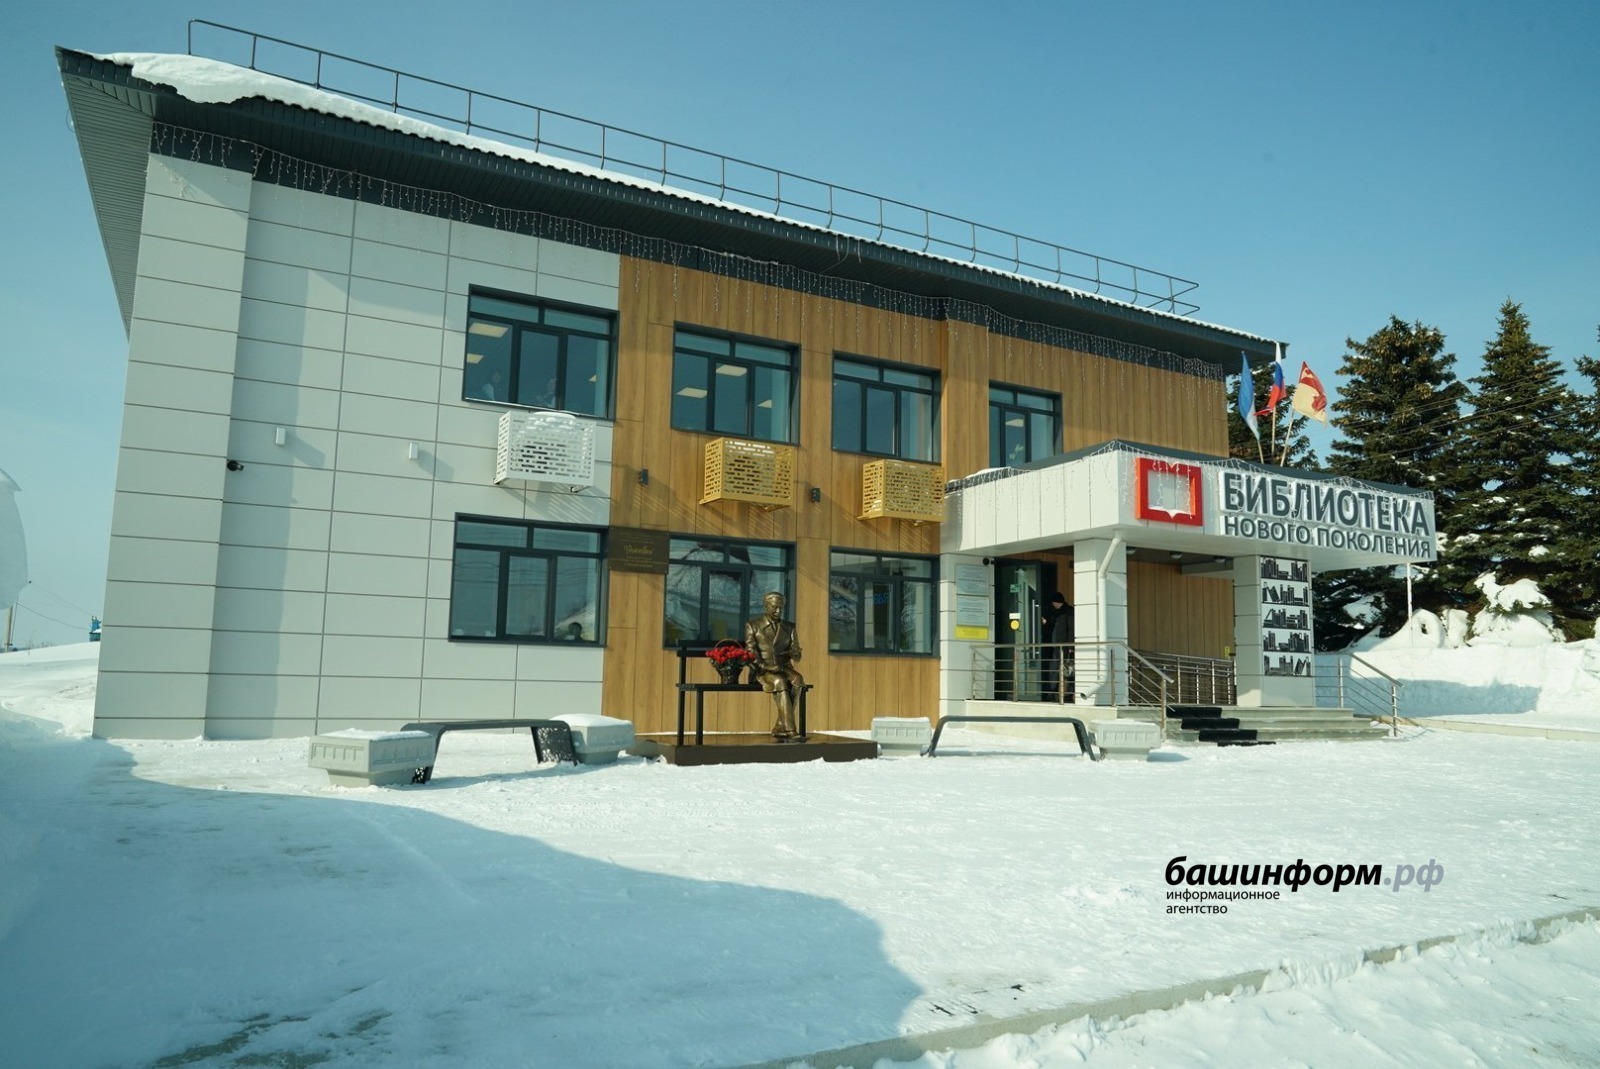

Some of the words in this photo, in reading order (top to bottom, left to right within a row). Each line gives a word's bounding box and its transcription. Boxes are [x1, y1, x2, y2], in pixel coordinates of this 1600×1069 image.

[1223, 471, 1431, 536] БИБЛИОТЕКА
[1224, 516, 1311, 545] НОВОГО
[1317, 528, 1431, 558] ПОКОЛЕНИЯ
